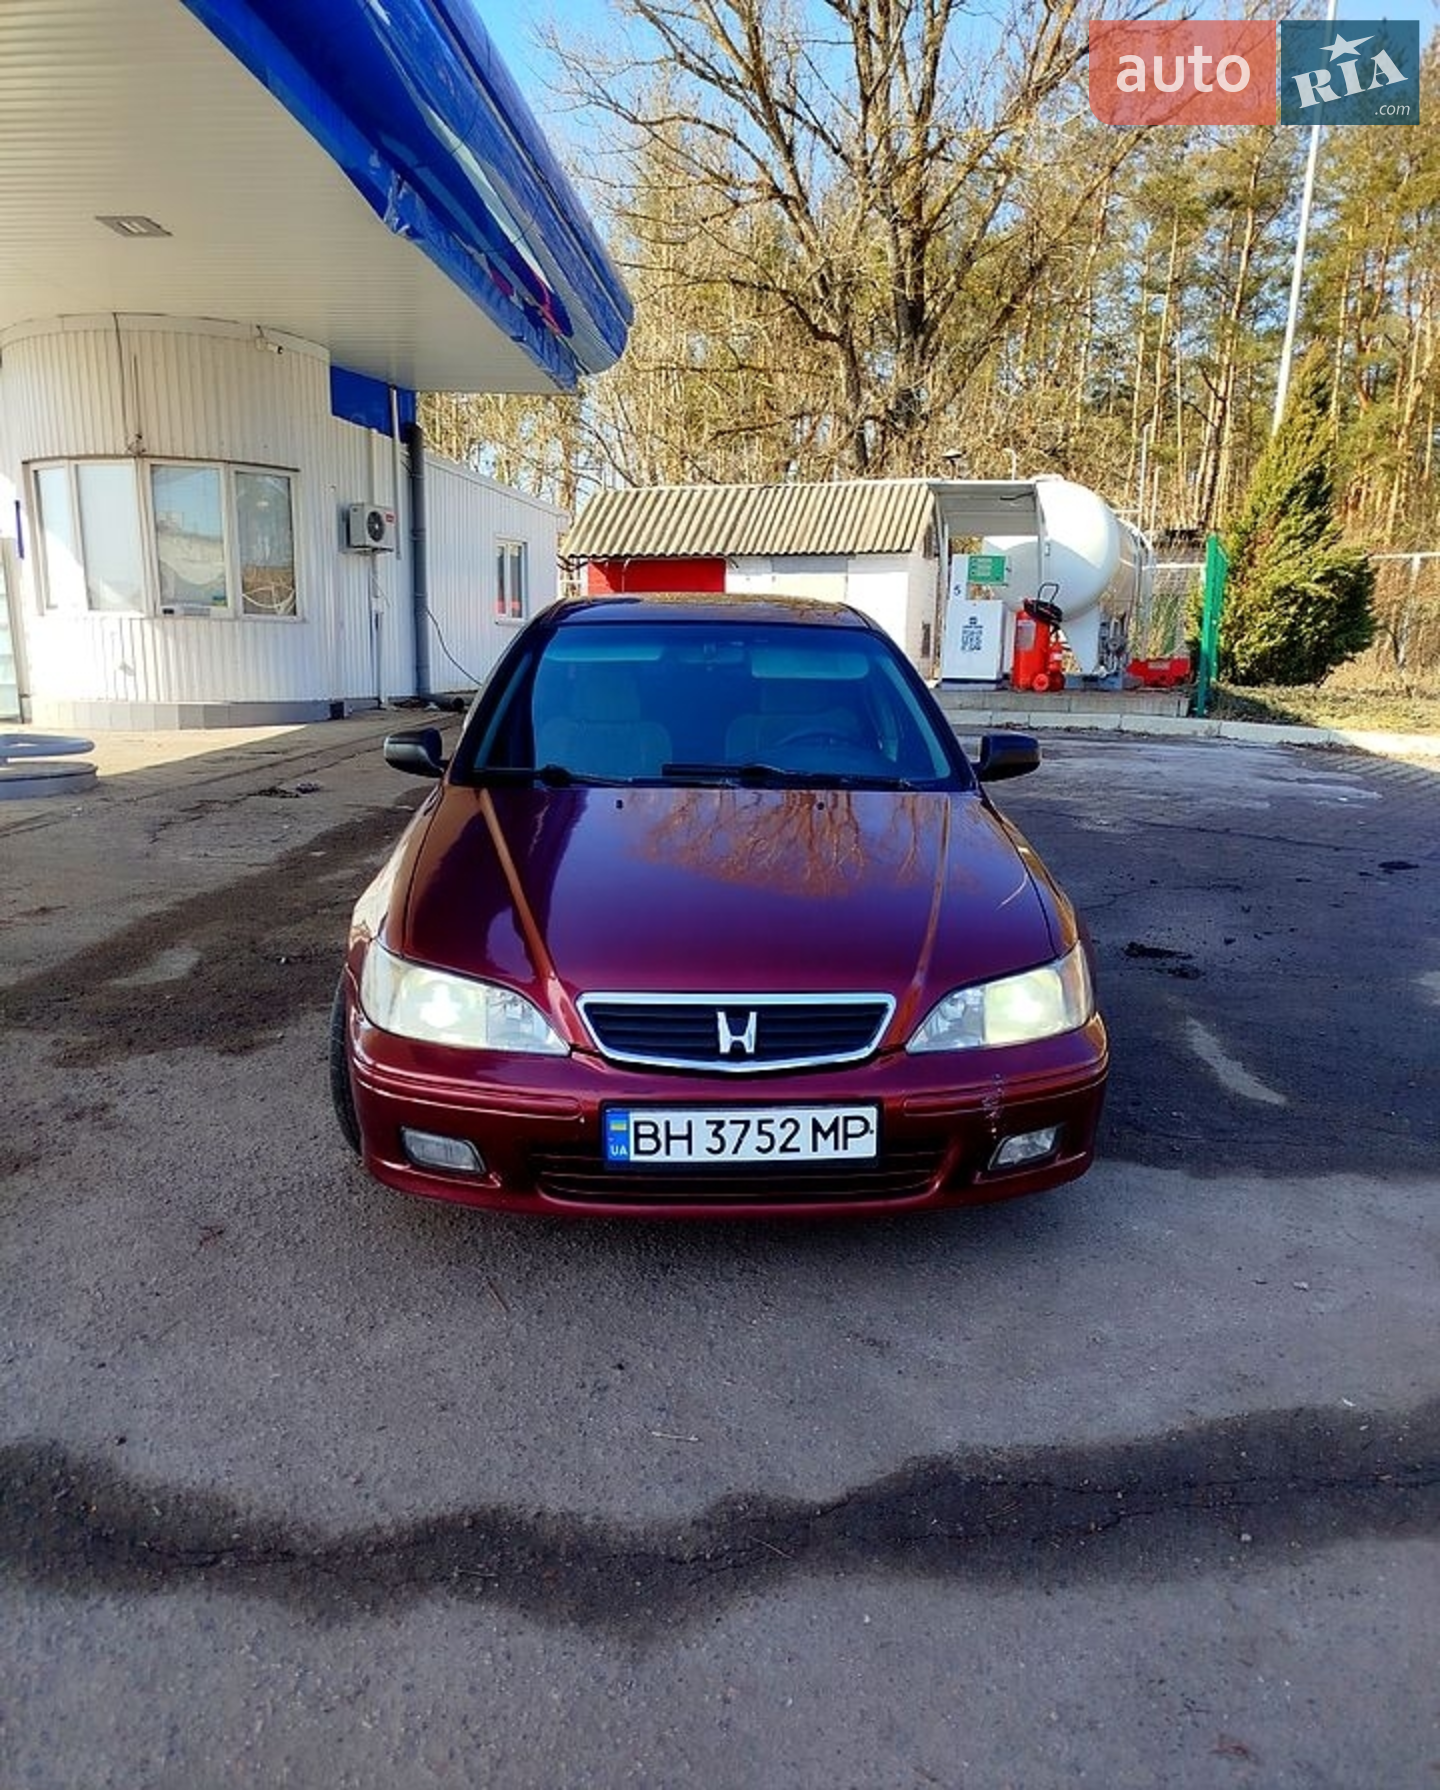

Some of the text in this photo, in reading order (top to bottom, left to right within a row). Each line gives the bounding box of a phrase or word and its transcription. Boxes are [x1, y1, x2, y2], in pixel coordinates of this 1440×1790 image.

[633, 1115, 871, 1156] BH 3752 MP
[610, 1145, 628, 1156] UA
